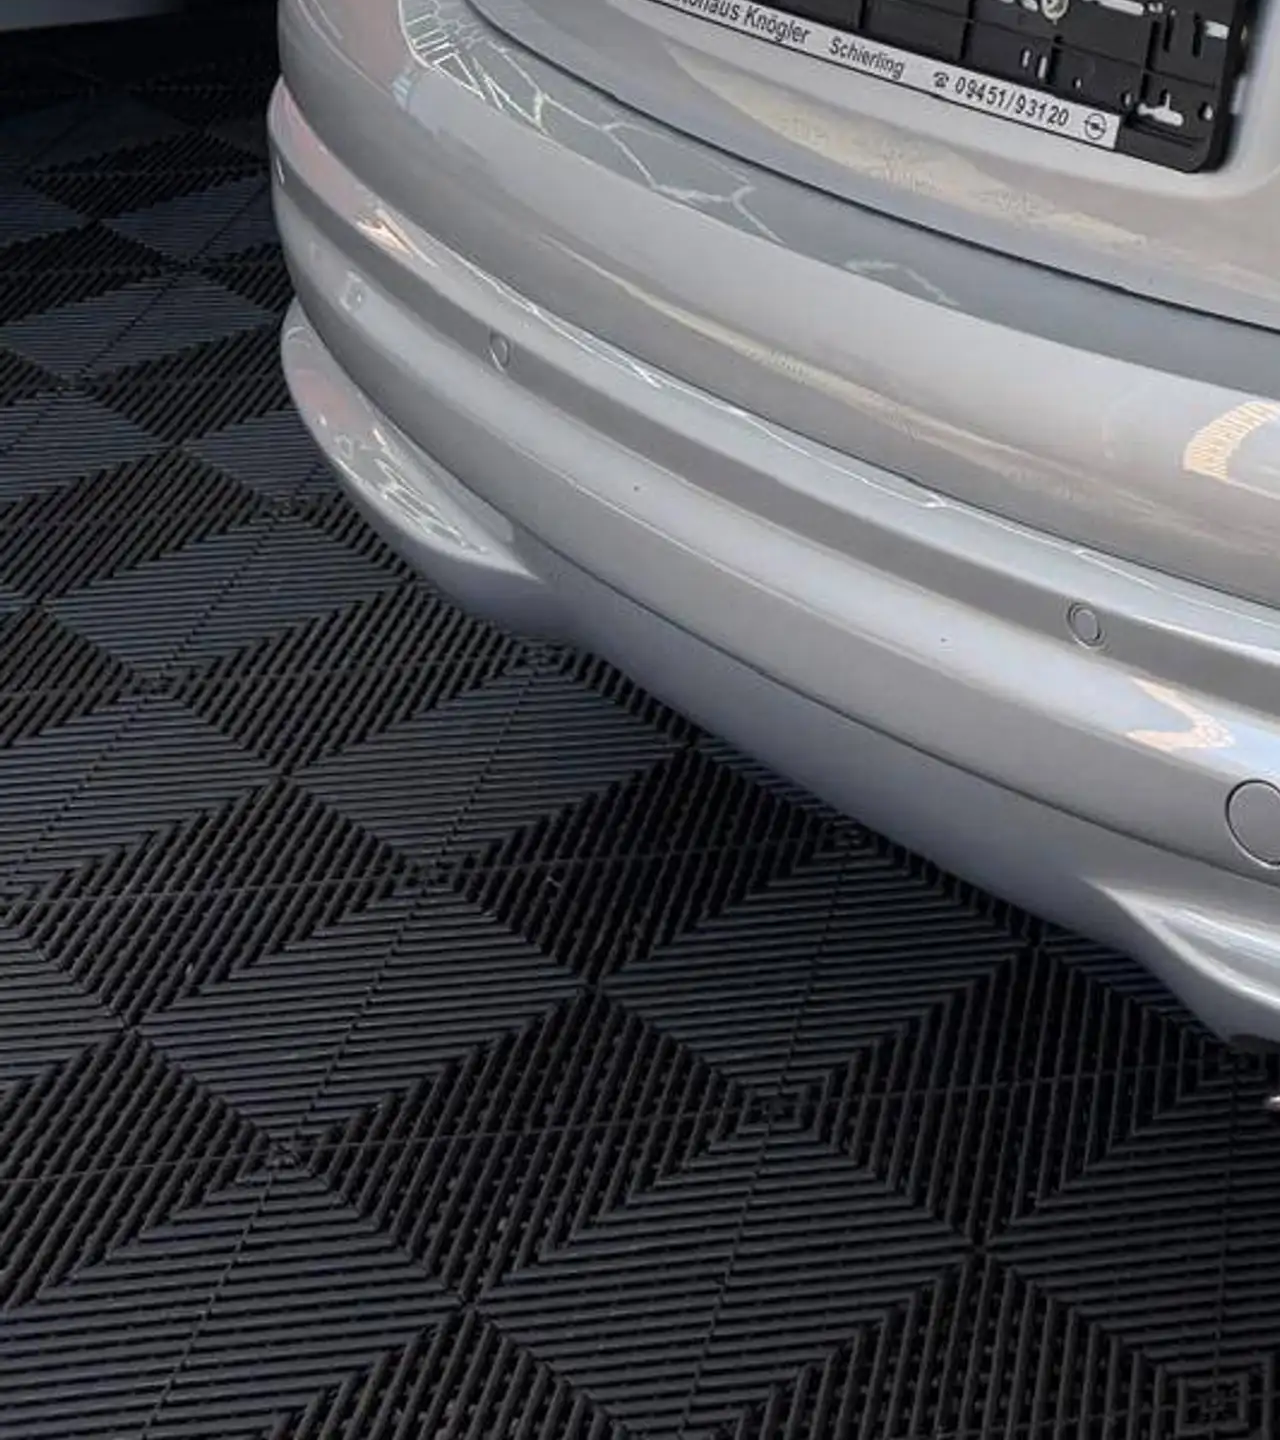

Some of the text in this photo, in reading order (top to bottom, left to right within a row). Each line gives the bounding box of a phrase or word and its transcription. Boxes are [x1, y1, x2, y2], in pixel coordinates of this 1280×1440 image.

[743, 5, 811, 45] Knögler
[828, 34, 905, 80] Schierling
[955, 75, 1071, 128] 09451/93120
